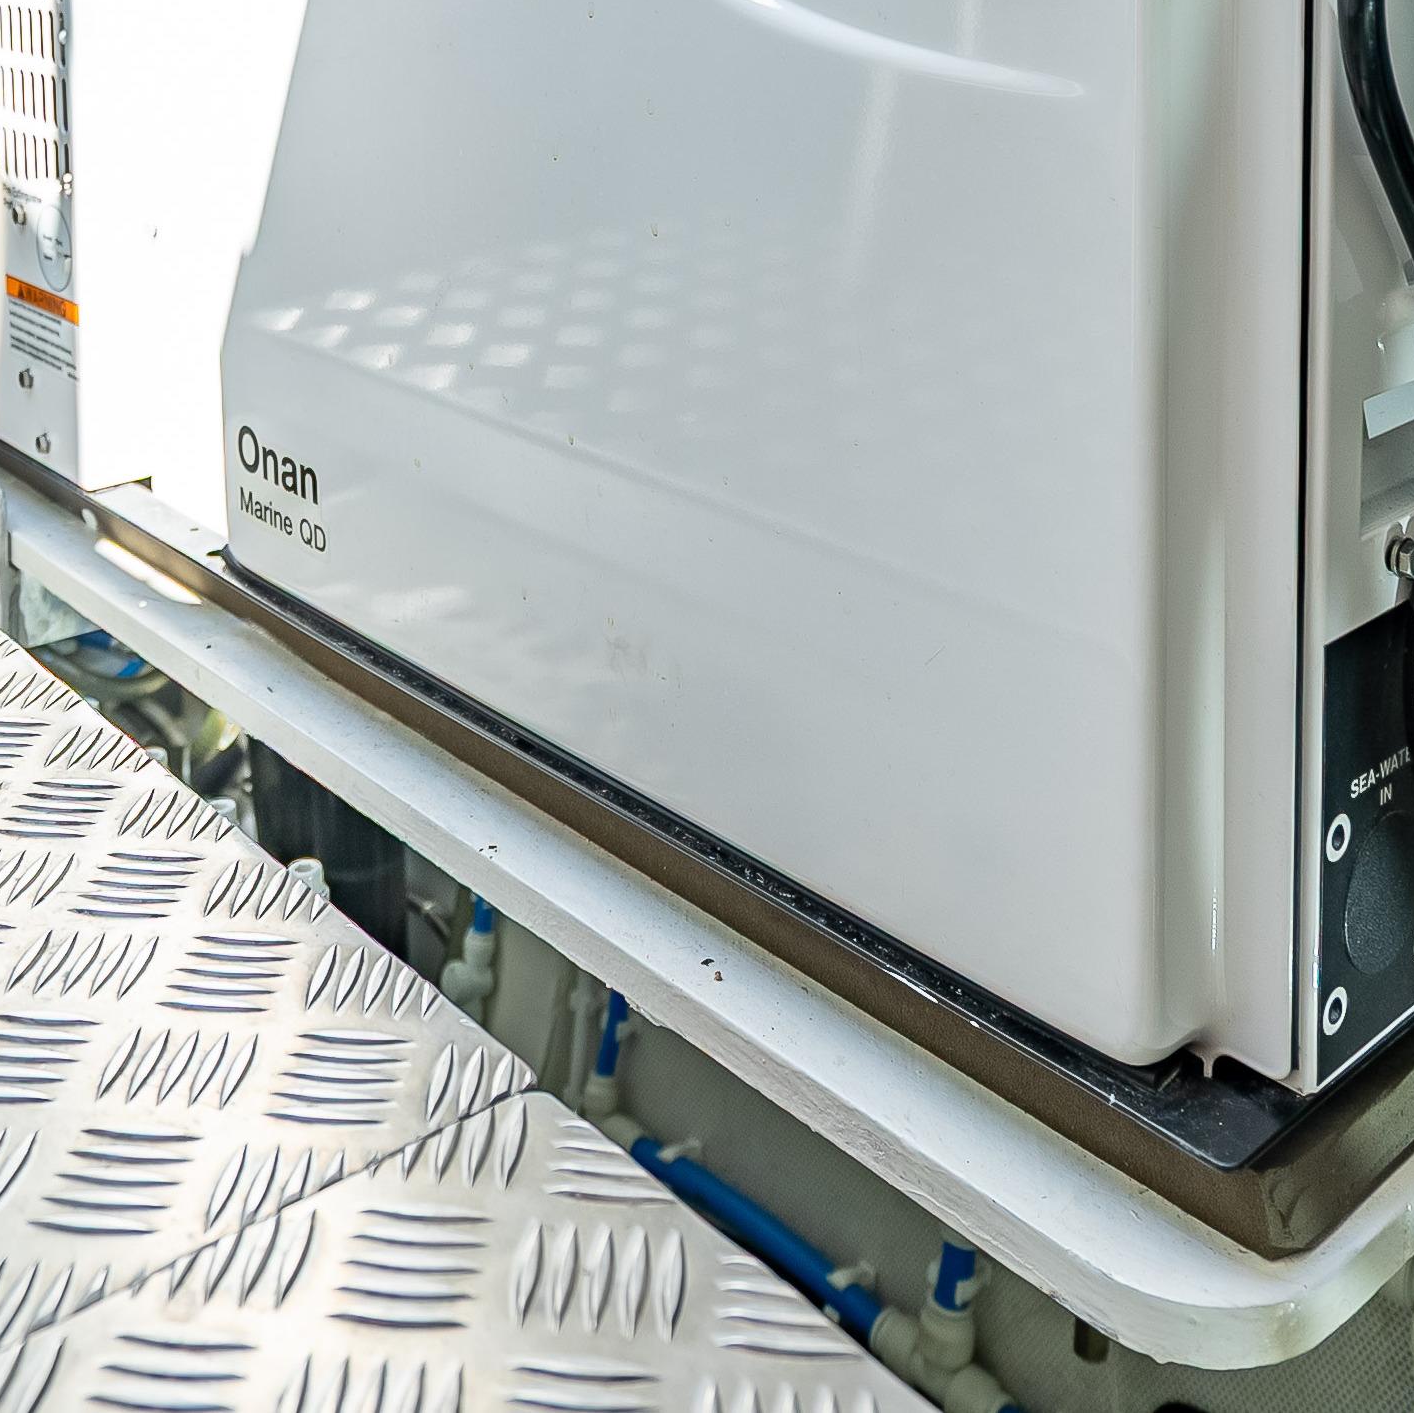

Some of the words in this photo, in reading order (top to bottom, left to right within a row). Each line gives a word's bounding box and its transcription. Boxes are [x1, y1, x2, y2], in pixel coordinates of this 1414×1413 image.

[238, 425, 318, 505] Onan
[240, 486, 293, 536] Marine
[300, 518, 327, 552] QD
[1350, 746, 1411, 799] SEA-WATE
[1379, 783, 1393, 806] IN
